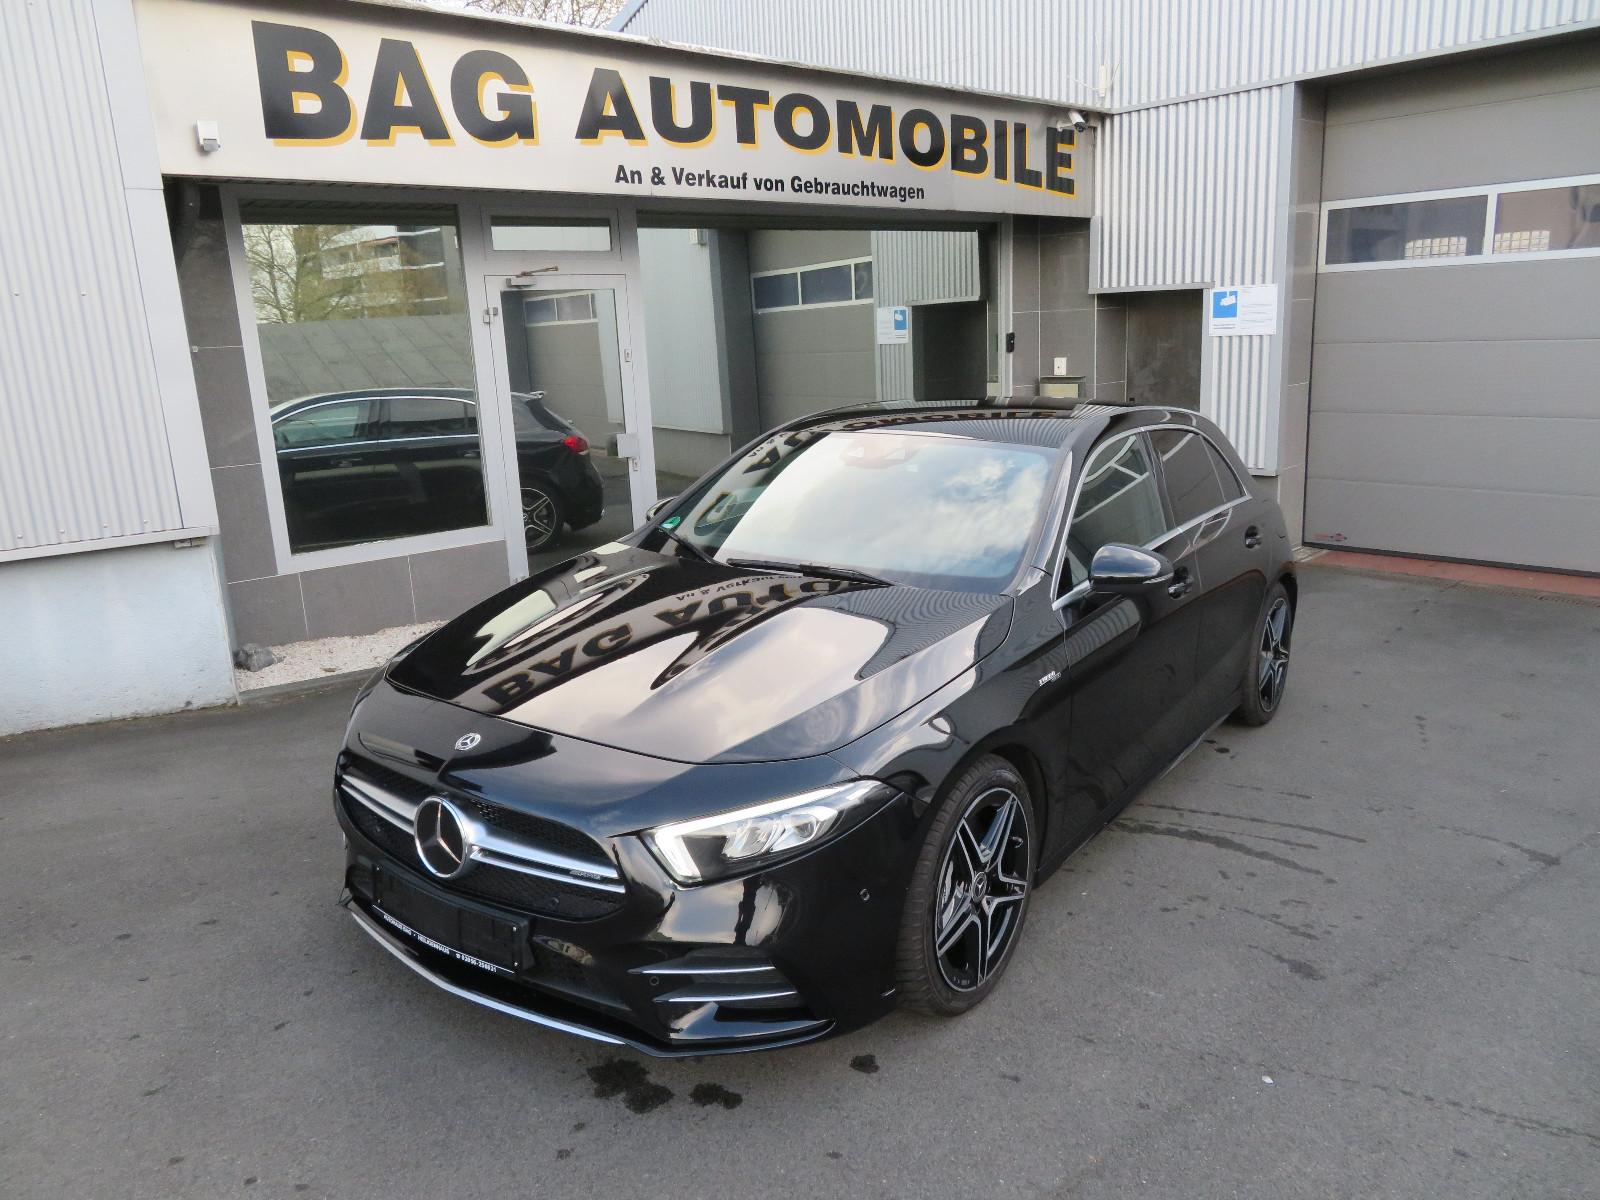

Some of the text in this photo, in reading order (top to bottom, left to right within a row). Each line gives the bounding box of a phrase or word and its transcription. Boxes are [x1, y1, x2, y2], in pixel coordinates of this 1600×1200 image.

[252, 20, 1077, 198] BAG AUTOMOBILE
[615, 165, 925, 202] An & Verkauf von Gebrauchtwagen
